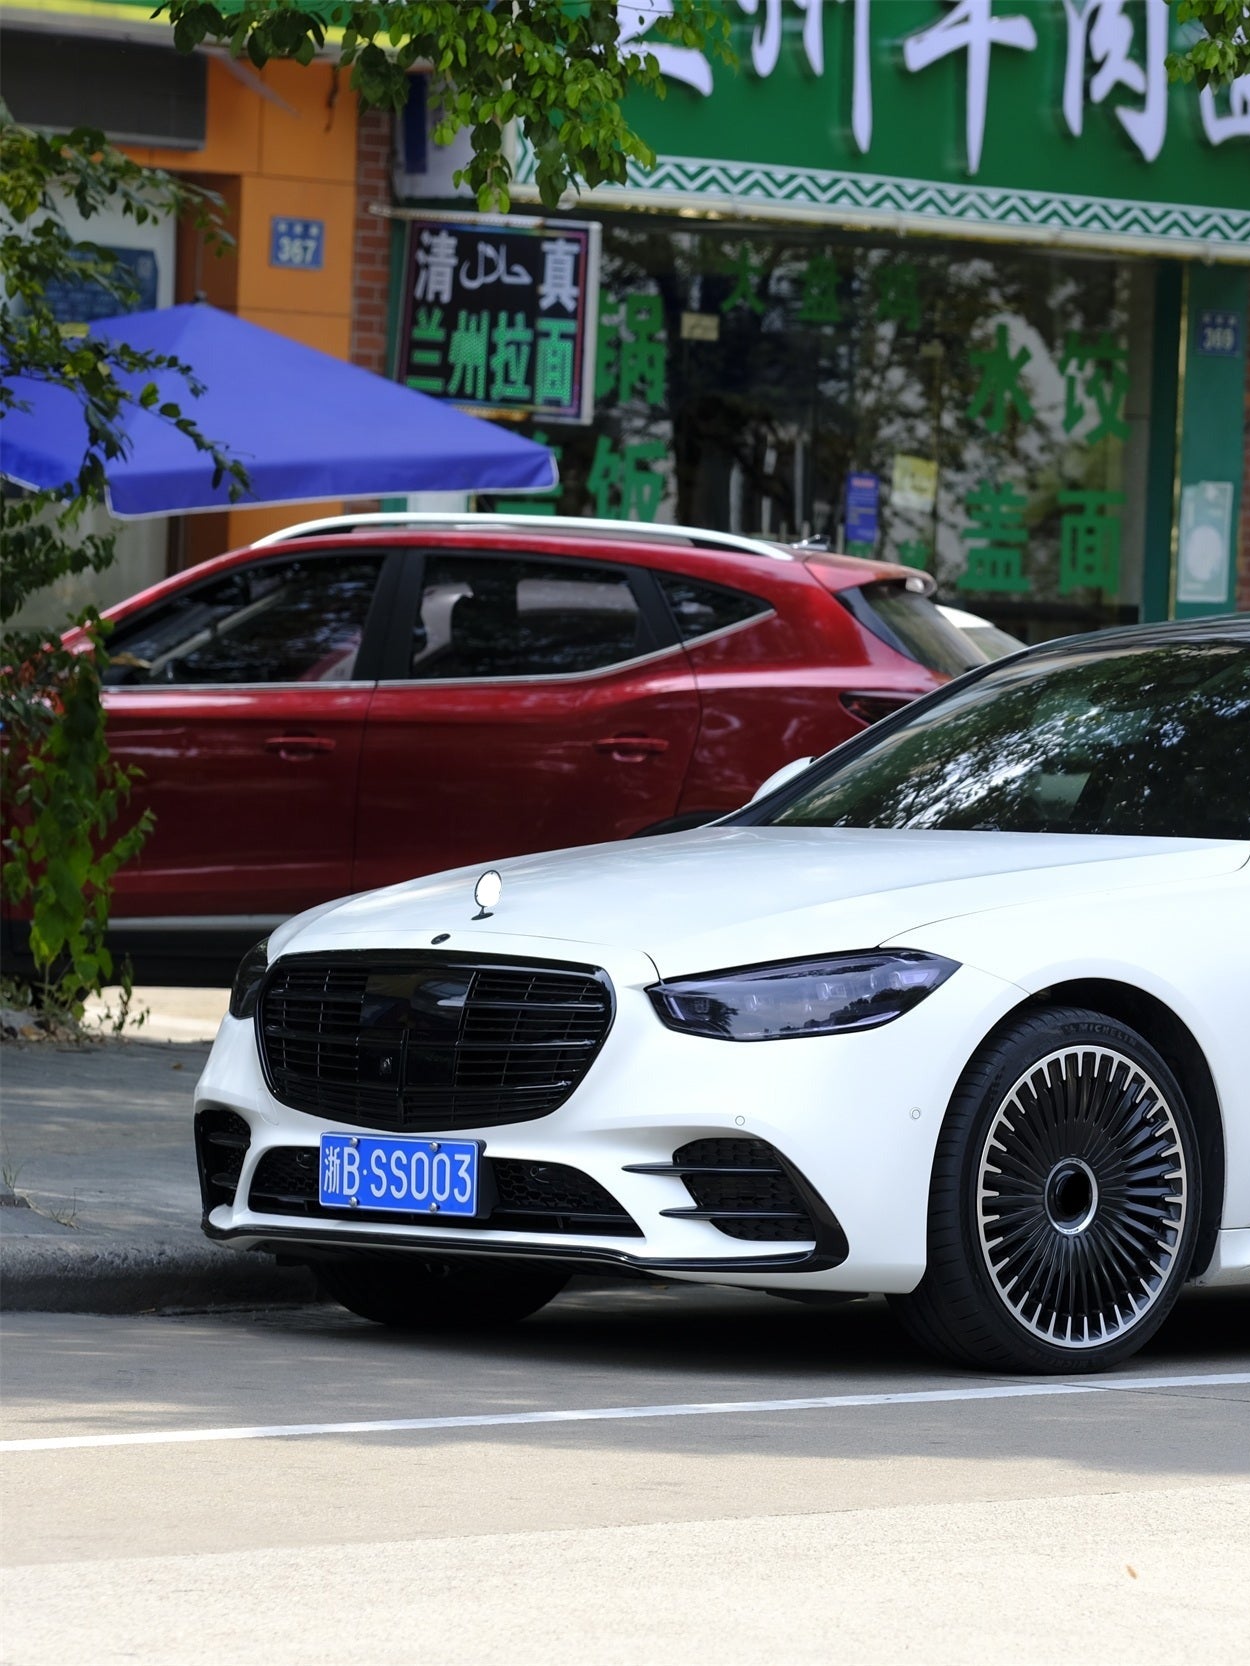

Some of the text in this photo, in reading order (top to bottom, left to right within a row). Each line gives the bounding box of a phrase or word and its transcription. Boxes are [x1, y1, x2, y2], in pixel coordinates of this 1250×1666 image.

[277, 235, 318, 265] 367
[413, 229, 459, 304] 清
[538, 239, 581, 313] 真
[404, 305, 579, 407] 兰州拉面
[966, 322, 1132, 446] 水饺
[957, 480, 1127, 596] 盖面
